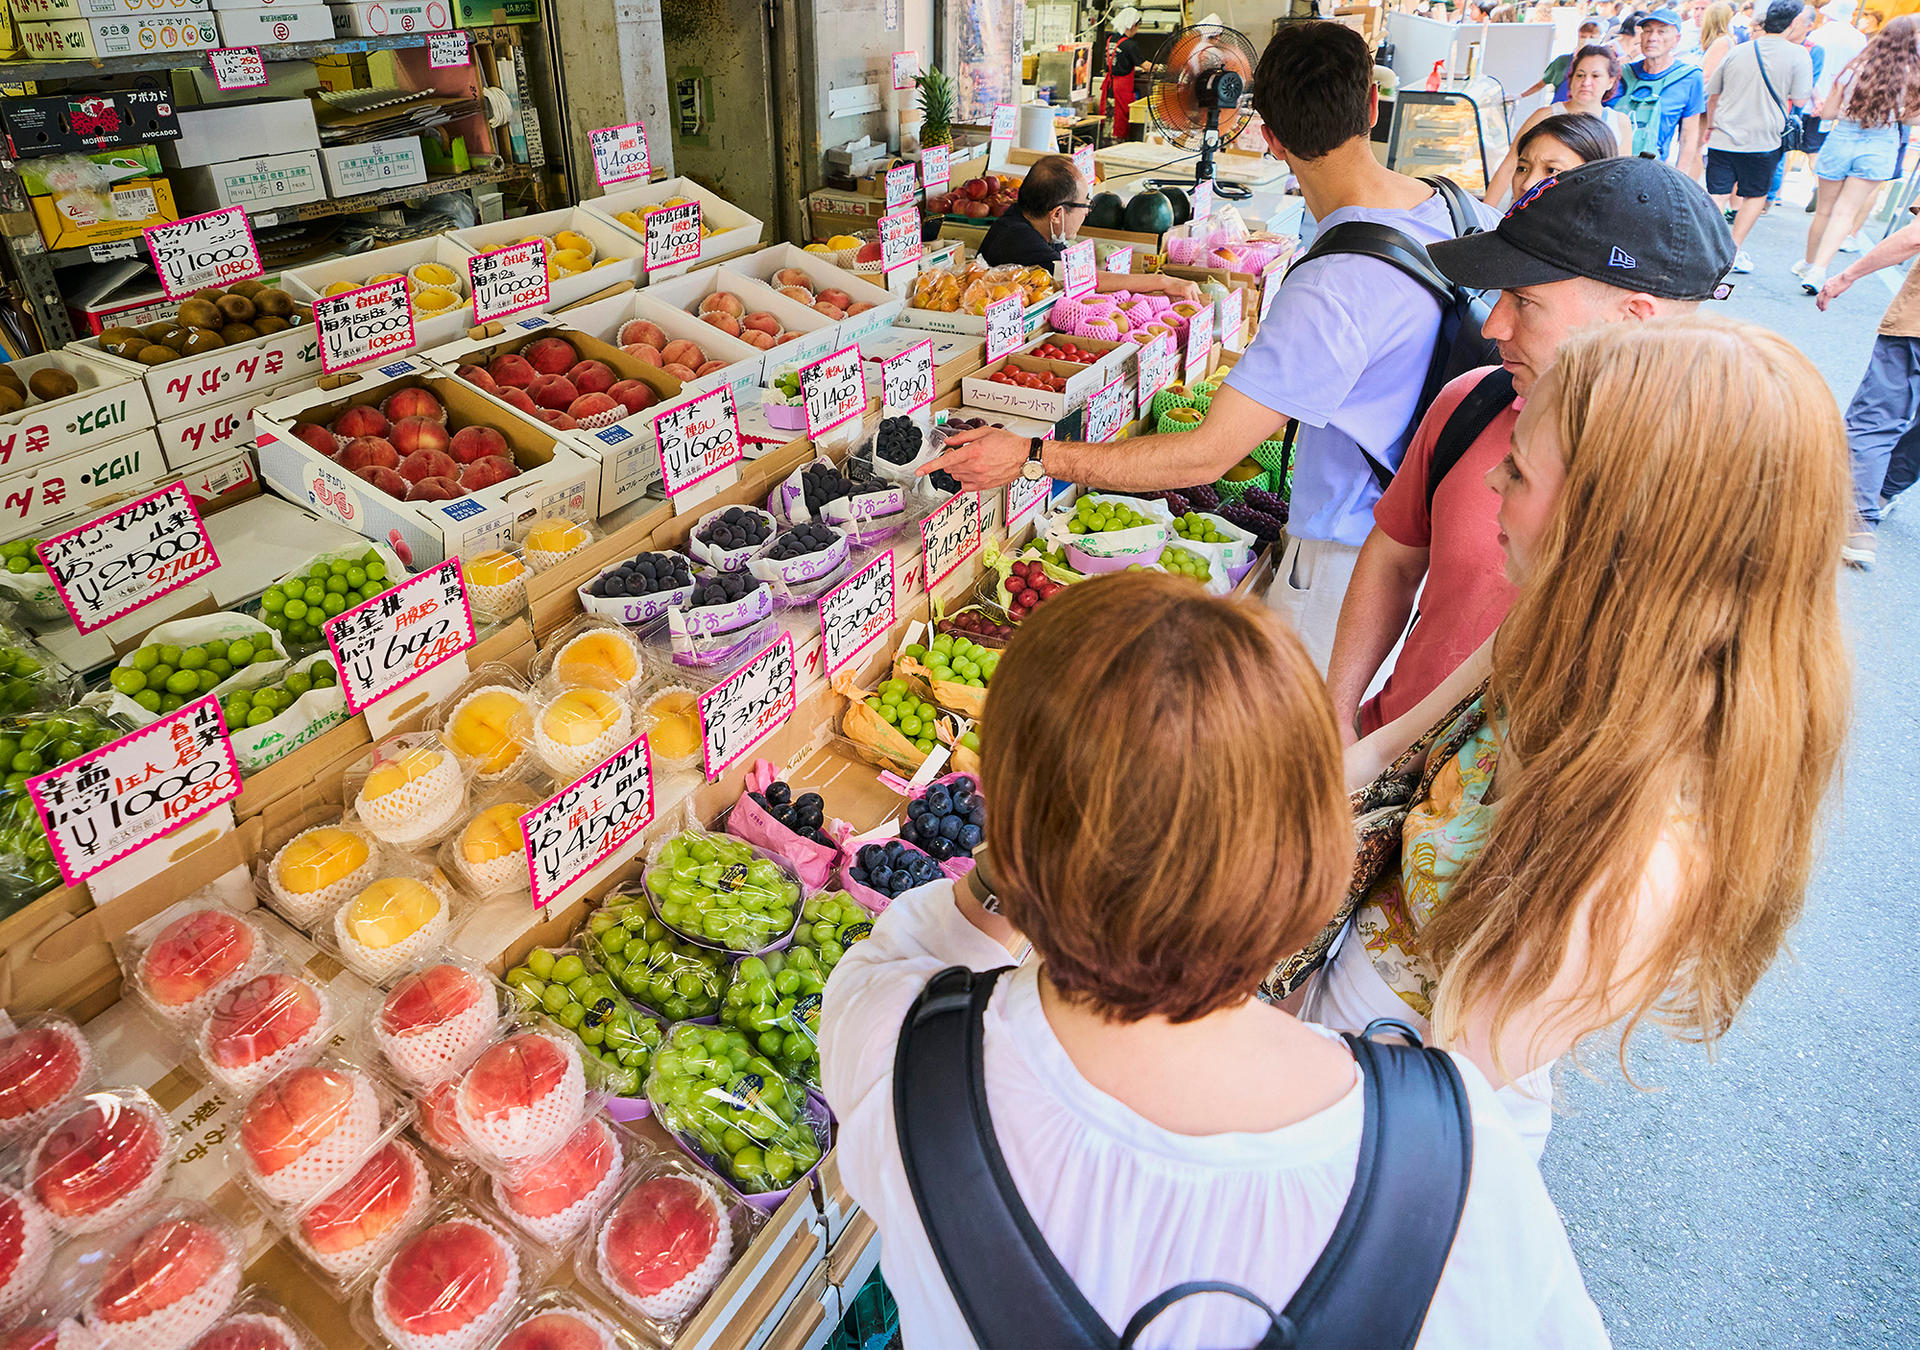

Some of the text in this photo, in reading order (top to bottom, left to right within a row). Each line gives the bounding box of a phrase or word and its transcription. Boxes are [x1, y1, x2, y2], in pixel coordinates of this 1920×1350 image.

[26, 31, 63, 51] きんかん
[240, 57, 259, 65] 250
[142, 129, 178, 138] AVOCADOS
[276, 181, 285, 192] 8
[383, 166, 391, 176] 8
[167, 350, 284, 403] きんかん
[883, 353, 911, 374] いちじく
[77, 400, 126, 435] ハウス
[657, 403, 700, 434] ピオーネ
[972, 389, 1056, 414] スーパーフルーツトマト
[4, 451, 140, 518] ハウス きん
[150, 509, 198, 543] 山梨
[147, 547, 210, 588] 2,700
[333, 562, 464, 645] 黄金桃 群馬
[395, 598, 439, 632] 月夜野
[414, 630, 462, 669] 648
[702, 645, 786, 714] ナガノパープル
[40, 707, 230, 805] 幸茜 春日居 山梨
[616, 766, 650, 798] 岡山
[568, 795, 608, 832] 晴王
